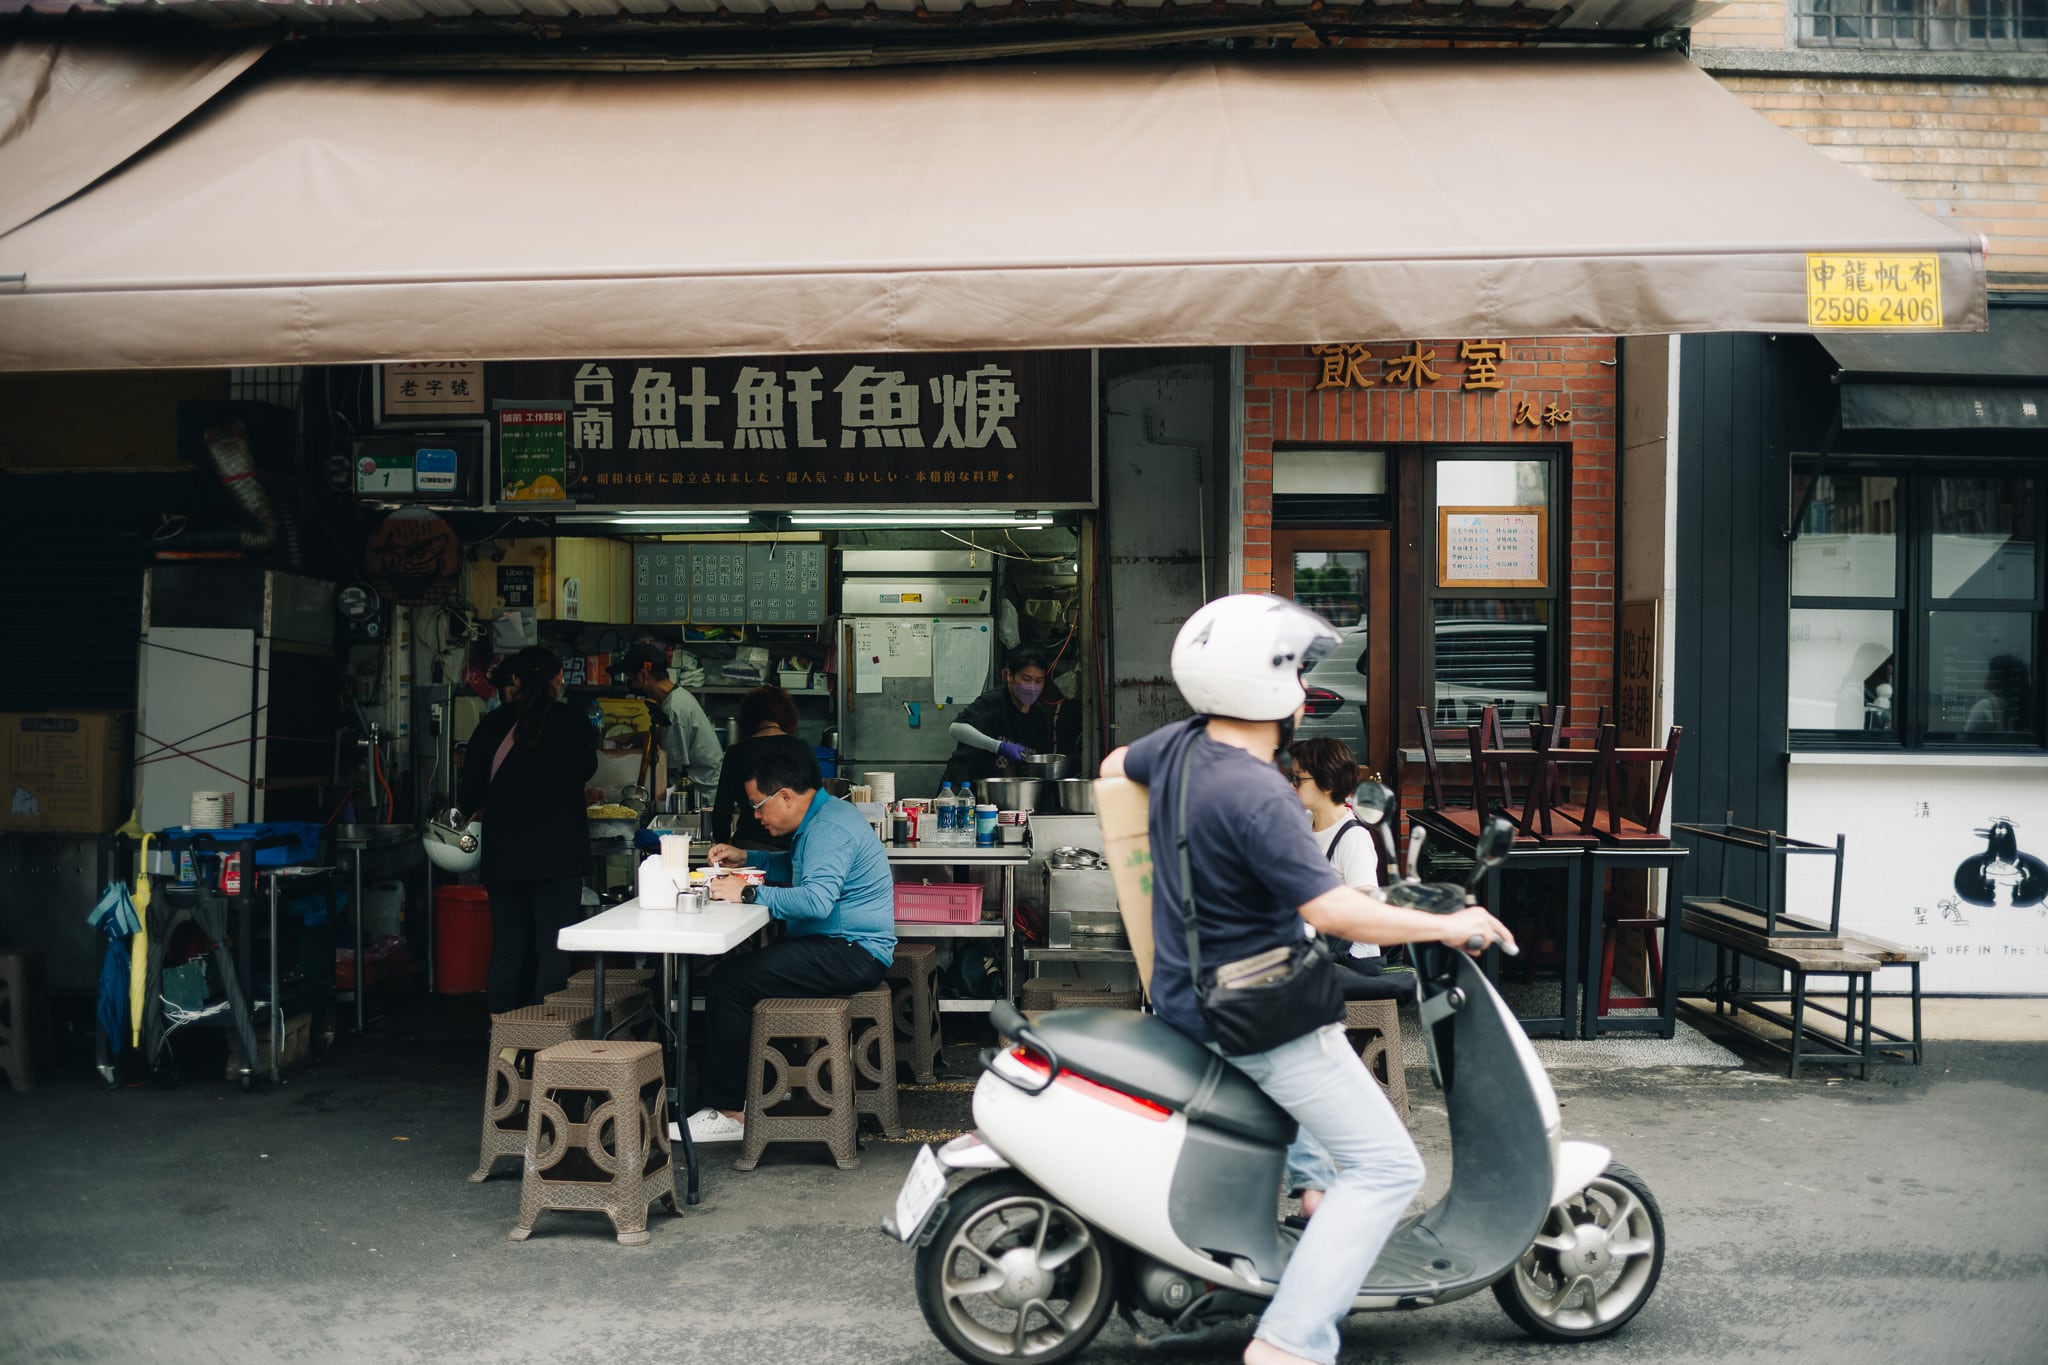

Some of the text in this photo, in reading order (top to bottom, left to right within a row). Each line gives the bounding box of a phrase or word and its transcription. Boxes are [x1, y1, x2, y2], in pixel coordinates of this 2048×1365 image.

[400, 378, 470, 397] 老字號
[573, 362, 614, 450] 台南
[1515, 400, 1573, 427] 久和
[1978, 945, 1991, 955] IN
